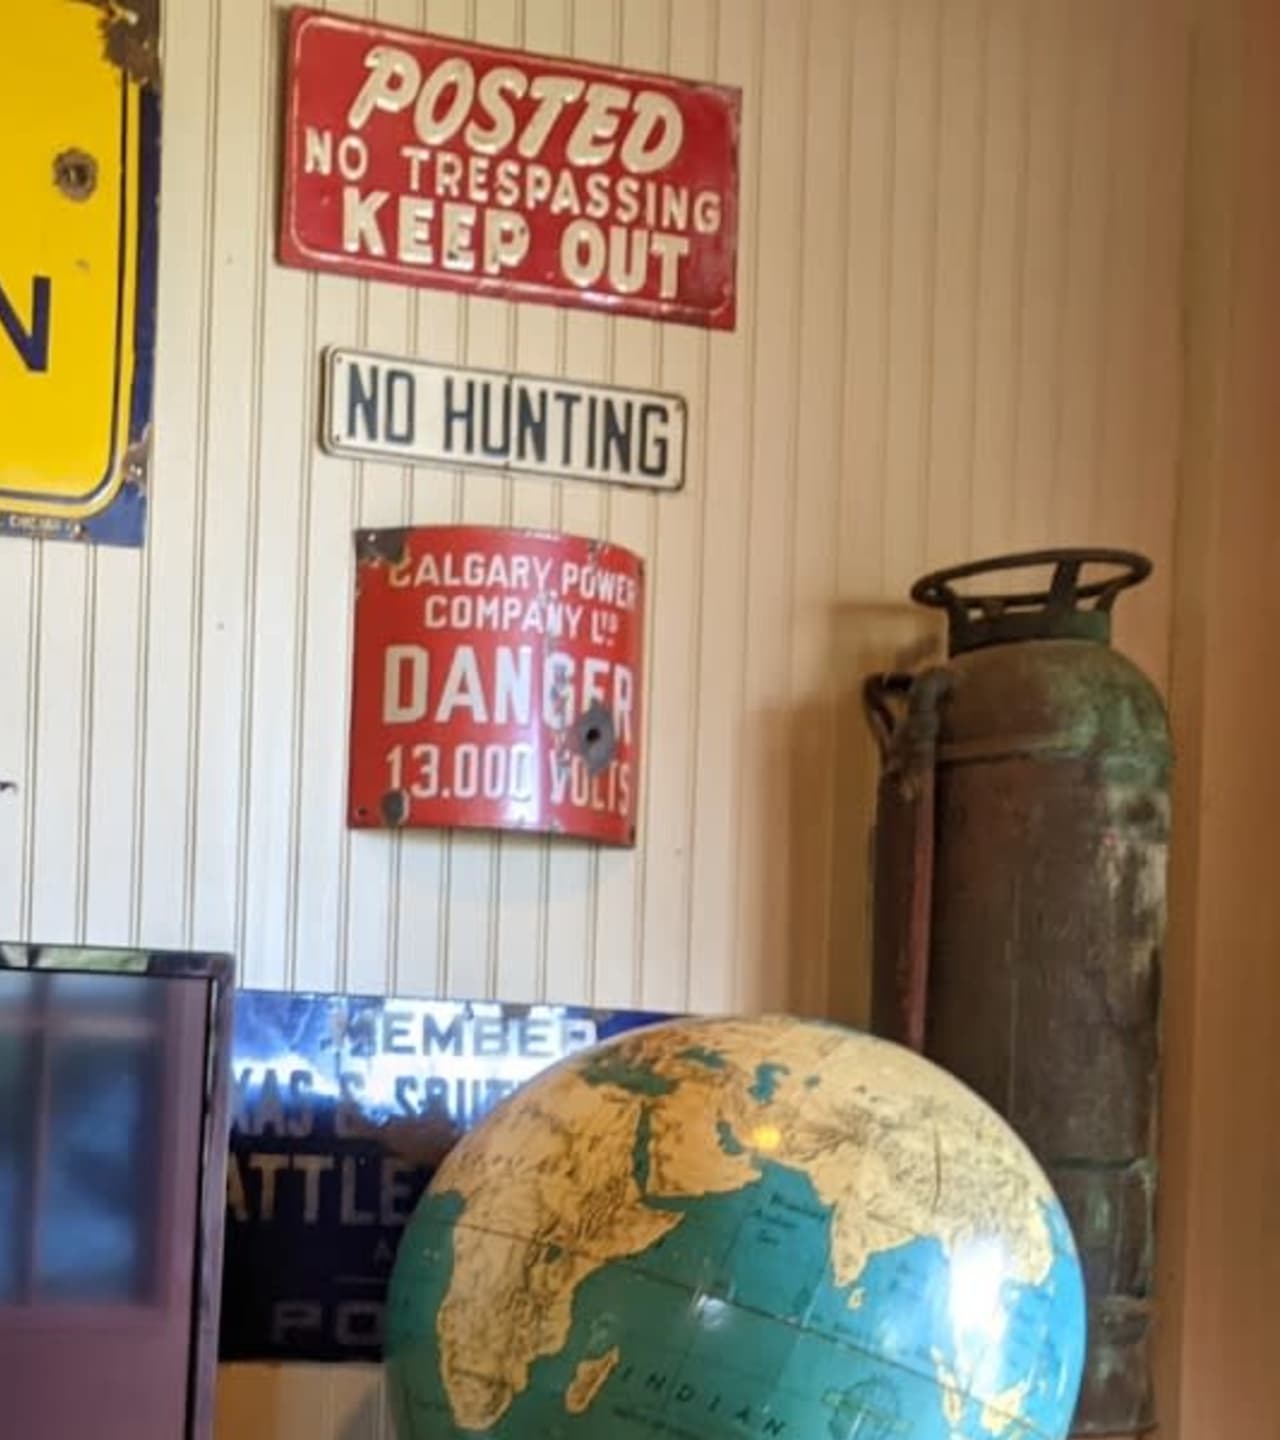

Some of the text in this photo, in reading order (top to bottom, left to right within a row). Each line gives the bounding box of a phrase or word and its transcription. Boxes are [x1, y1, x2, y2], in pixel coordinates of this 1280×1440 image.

[347, 45, 684, 174] POSTED
[304, 127, 722, 235] NO TRESPASSING
[342, 186, 690, 299] KEEP OUT
[346, 362, 669, 479] NO HUNTING
[389, 552, 636, 610] CALGARY POWER
[424, 594, 584, 639] COMPANY
[383, 643, 635, 746] DANGER
[549, 748, 632, 819] VOLTS
[620, 1365, 788, 1438] INDIAN
